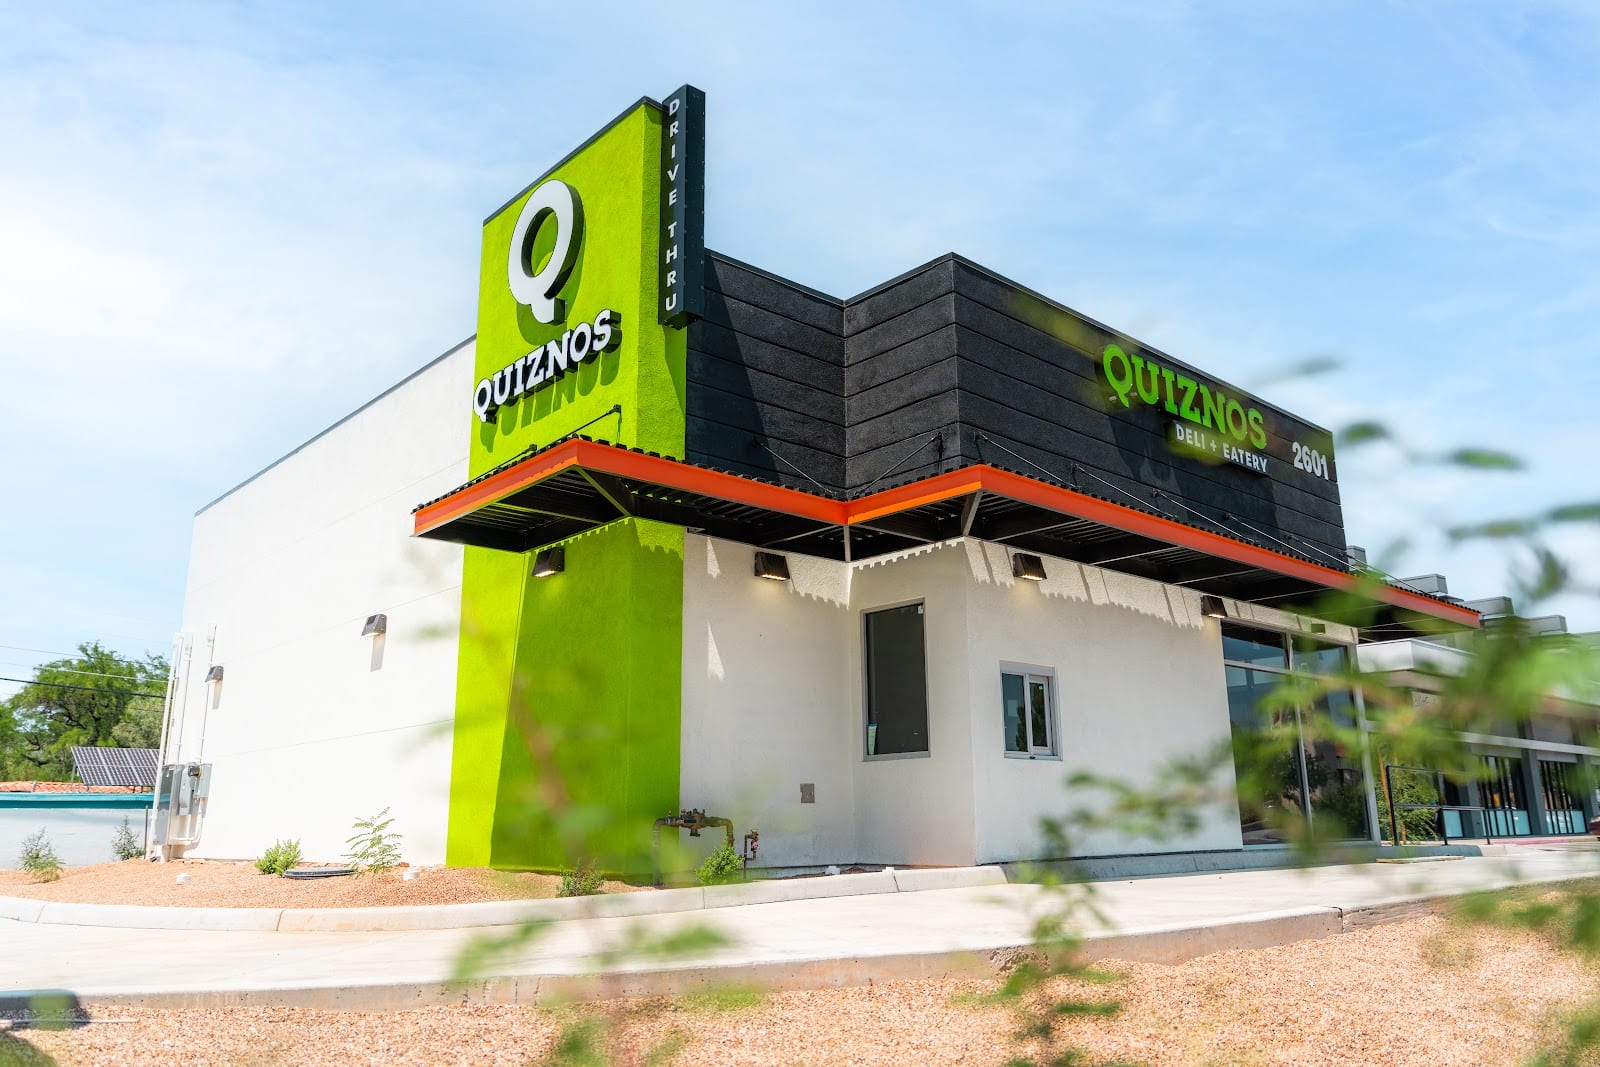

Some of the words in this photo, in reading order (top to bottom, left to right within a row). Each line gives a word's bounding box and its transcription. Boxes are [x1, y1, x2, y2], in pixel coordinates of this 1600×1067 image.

[666, 98, 680, 205] DRIVE
[507, 178, 575, 324] Q
[665, 222, 678, 311] THRU
[473, 309, 615, 422] QUIZNOS
[1103, 344, 1267, 449] QUIZNOS
[1175, 424, 1206, 449] DELI
[1223, 443, 1268, 473] EATERY
[1292, 442, 1329, 481] 2601
